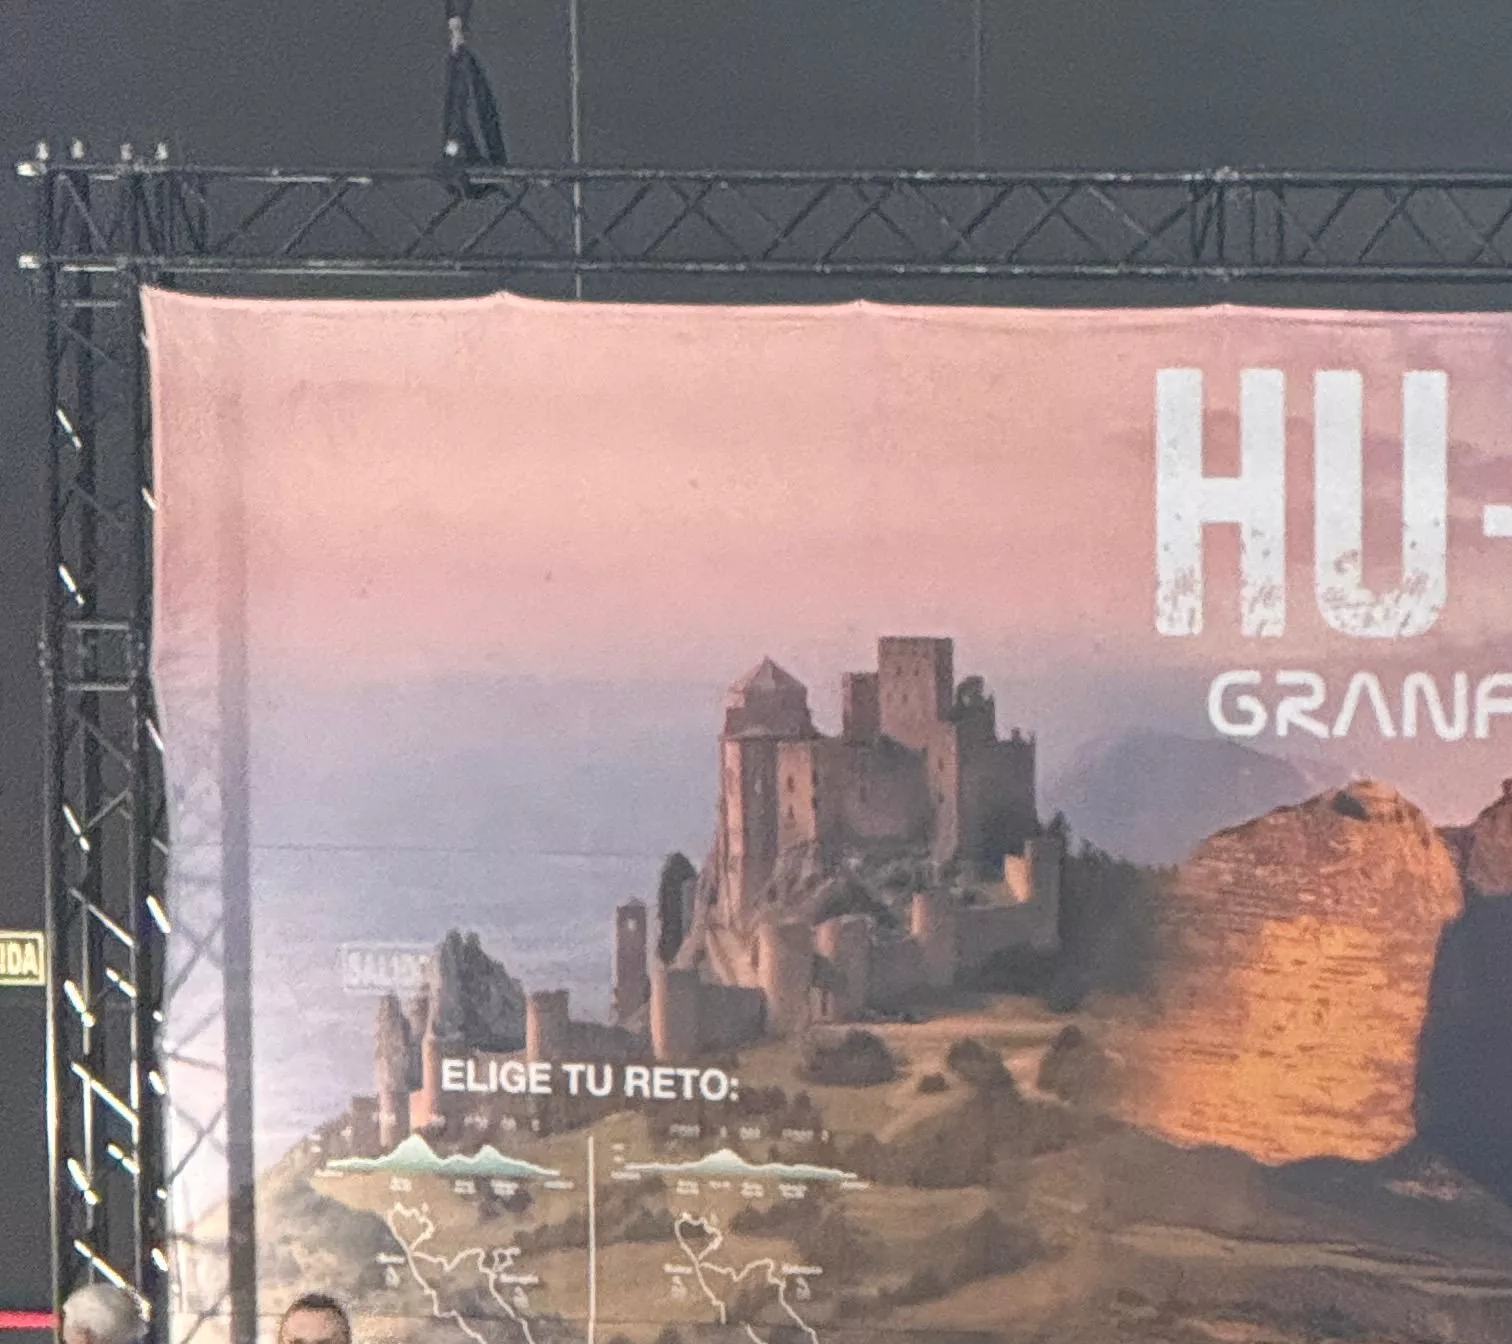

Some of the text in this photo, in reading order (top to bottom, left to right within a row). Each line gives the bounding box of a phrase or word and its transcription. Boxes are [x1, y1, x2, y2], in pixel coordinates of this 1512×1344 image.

[441, 1058, 740, 1102] ELIGE TU RETO:
